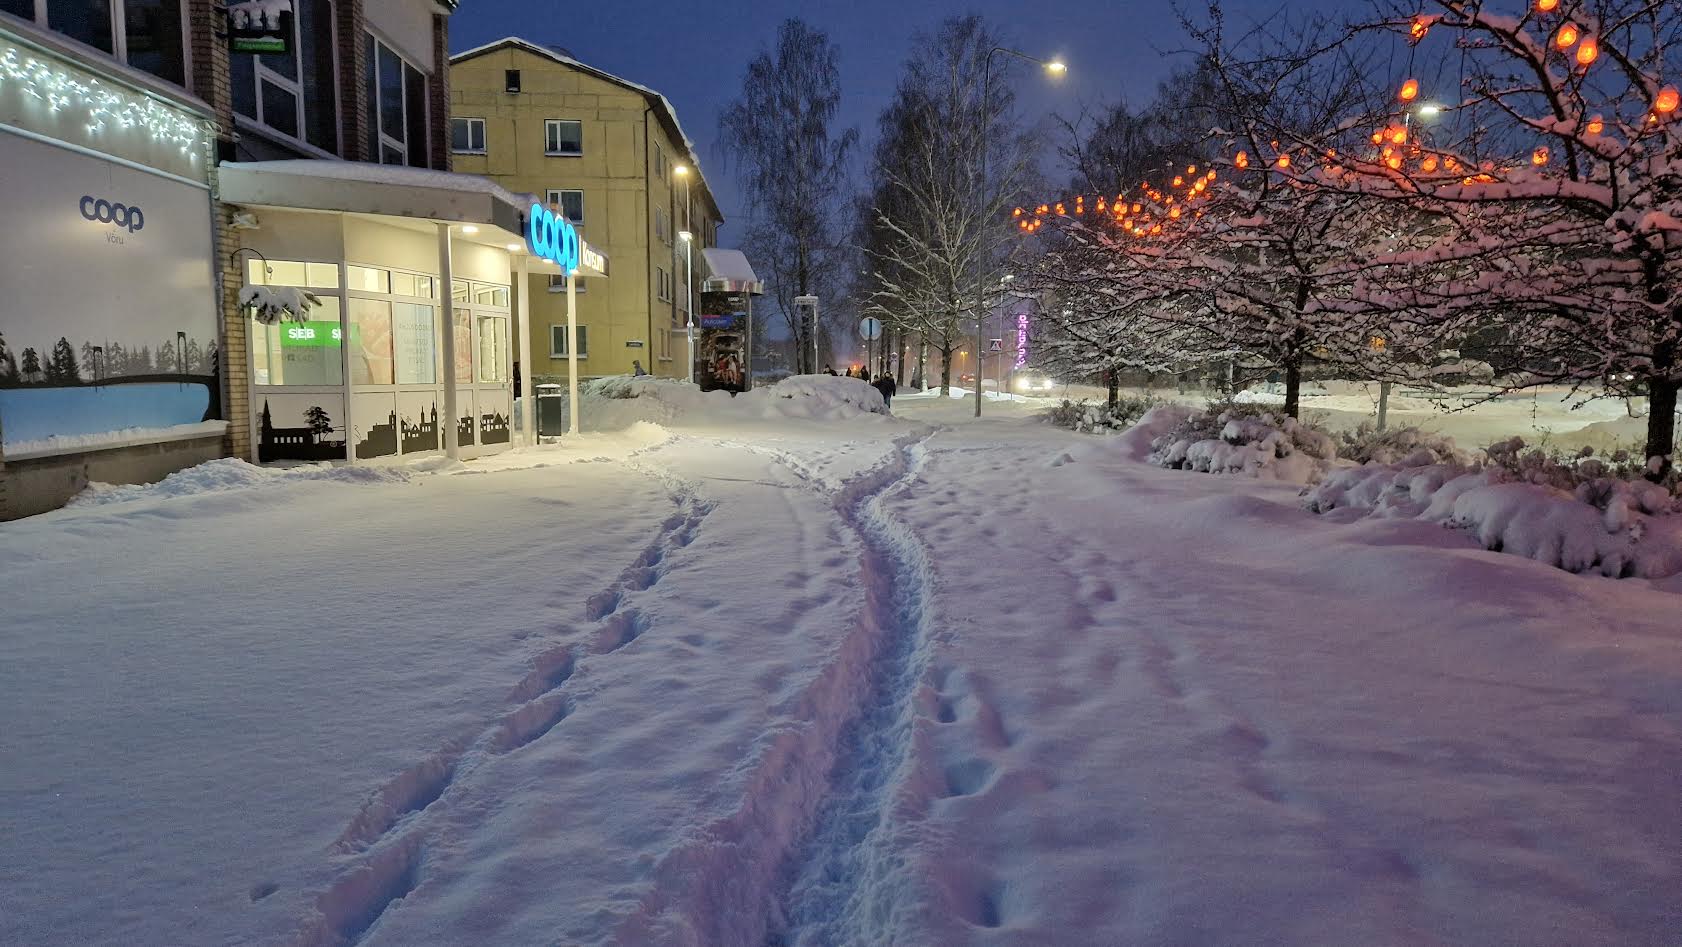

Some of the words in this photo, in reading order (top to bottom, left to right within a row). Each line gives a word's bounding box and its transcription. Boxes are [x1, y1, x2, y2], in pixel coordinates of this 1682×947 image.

[79, 195, 144, 233] coop
[531, 203, 577, 277] coop
[582, 240, 604, 272] Konsum
[288, 326, 315, 340] SEB
